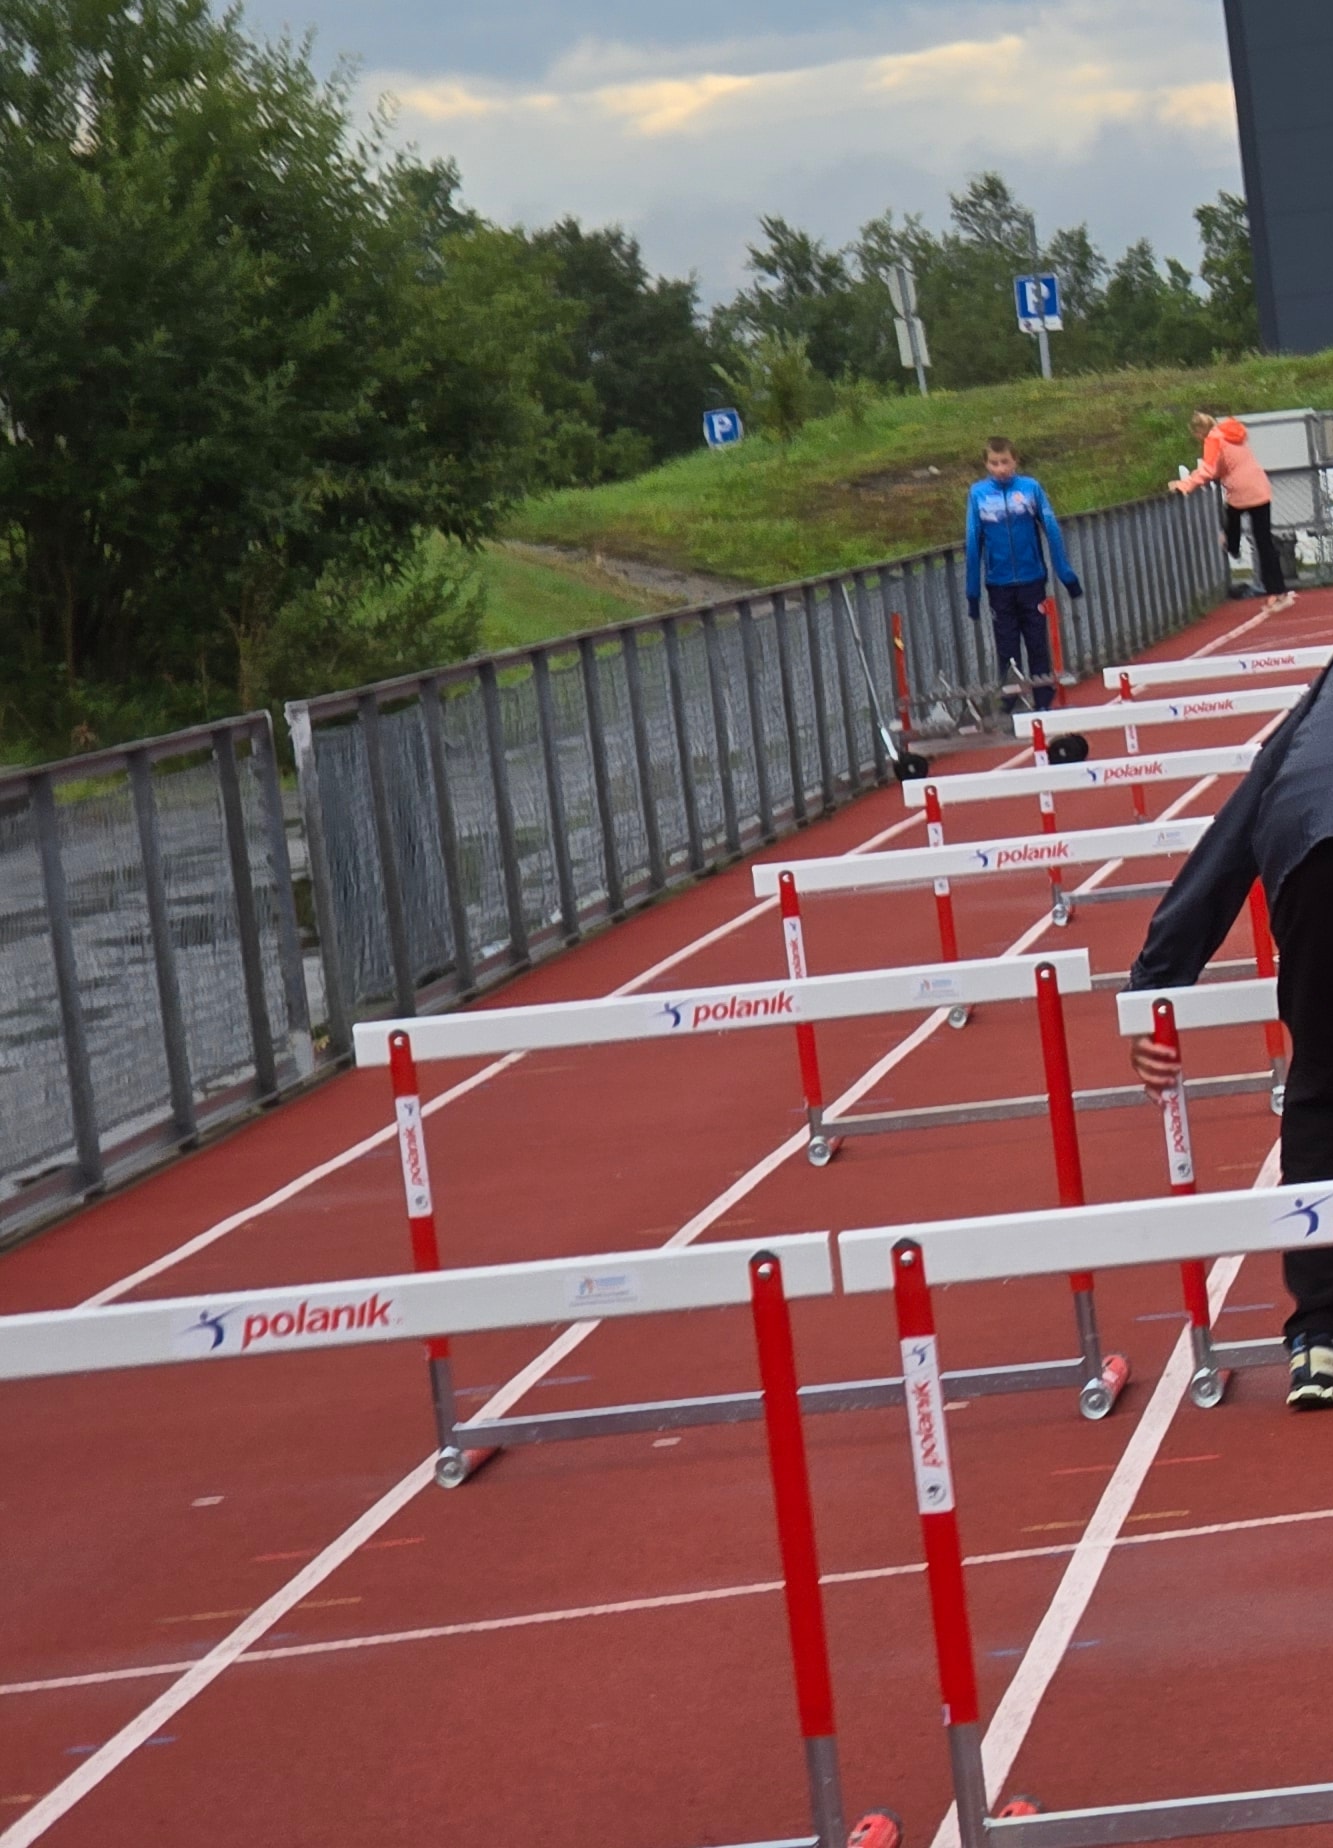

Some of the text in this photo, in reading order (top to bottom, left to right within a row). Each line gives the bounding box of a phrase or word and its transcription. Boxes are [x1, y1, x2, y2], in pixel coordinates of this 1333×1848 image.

[1024, 281, 1051, 314] P
[711, 413, 733, 442] P
[996, 840, 1070, 867] polanik
[690, 990, 792, 1030] polanik
[241, 1293, 392, 1351] polanik
